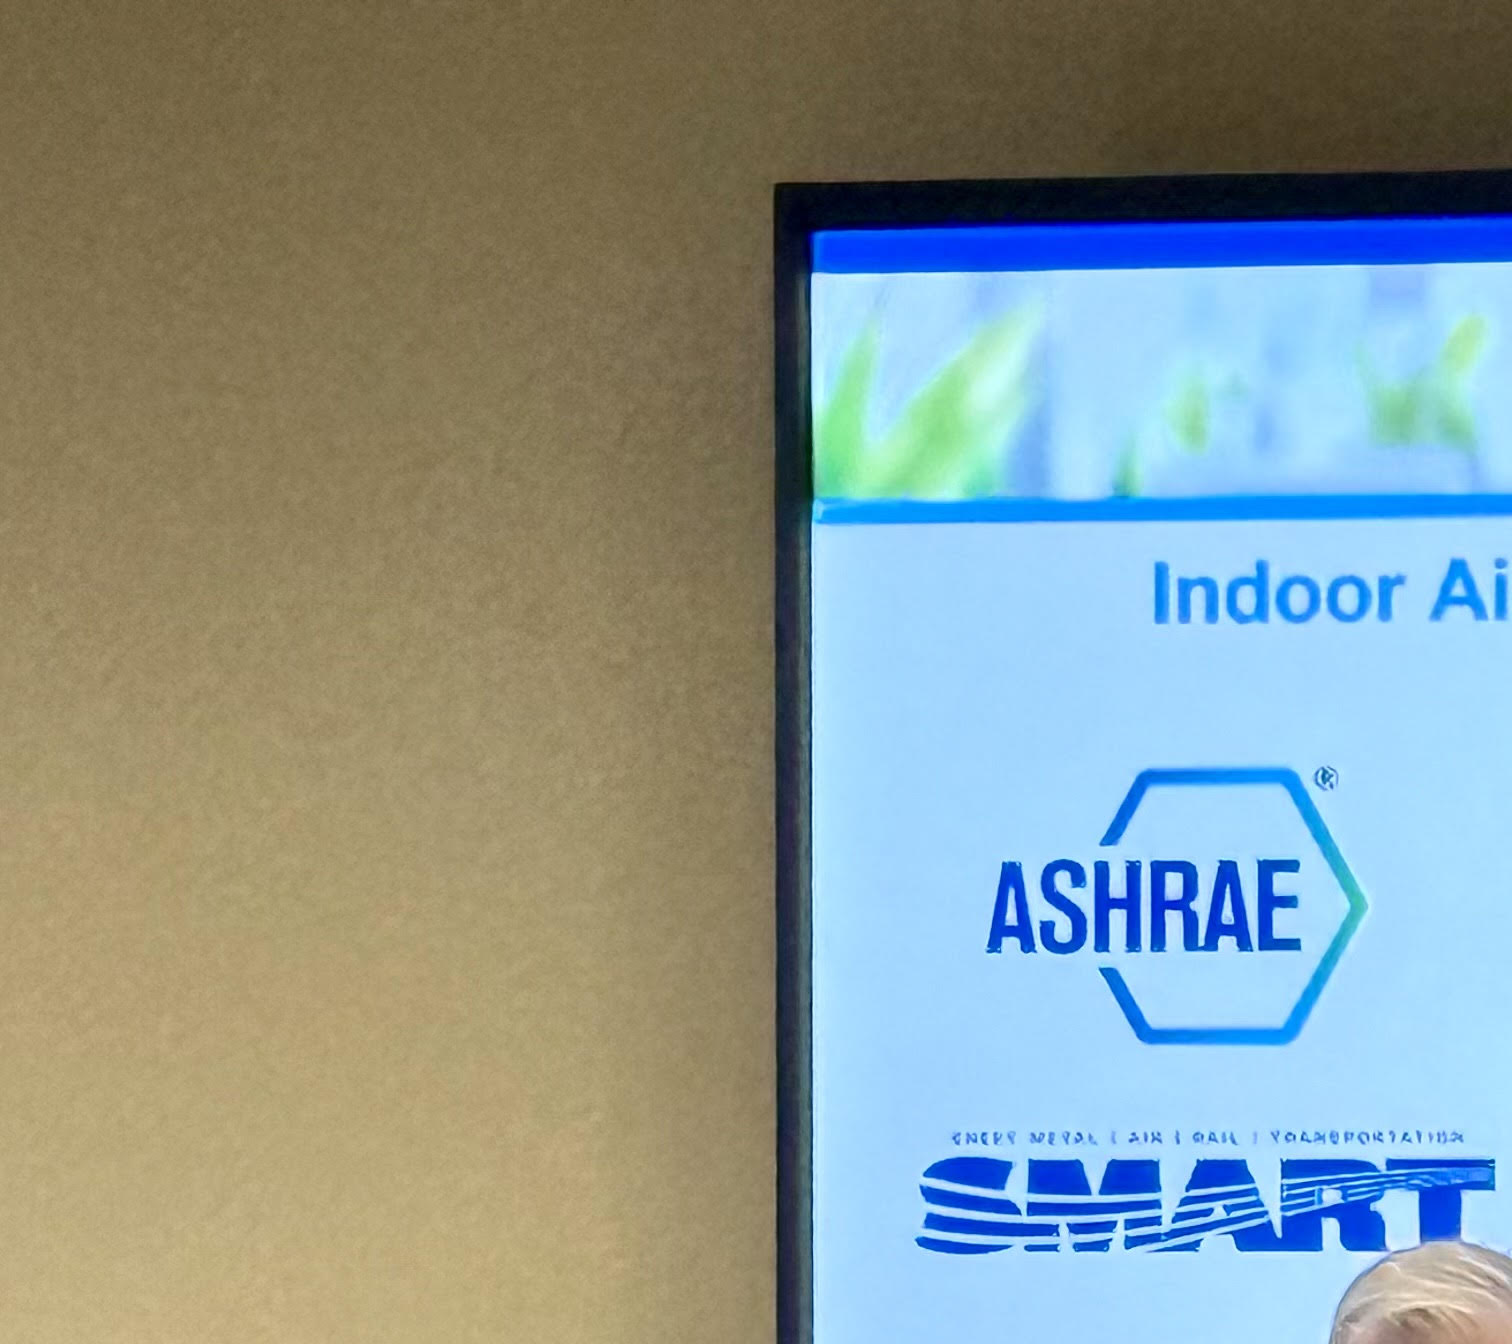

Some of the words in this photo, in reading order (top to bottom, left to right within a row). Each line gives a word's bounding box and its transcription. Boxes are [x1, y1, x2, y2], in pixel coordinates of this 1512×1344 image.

[1153, 559, 1406, 625] Indoor
[985, 858, 1302, 955] ASHRAE
[914, 1155, 1496, 1255] SMART
